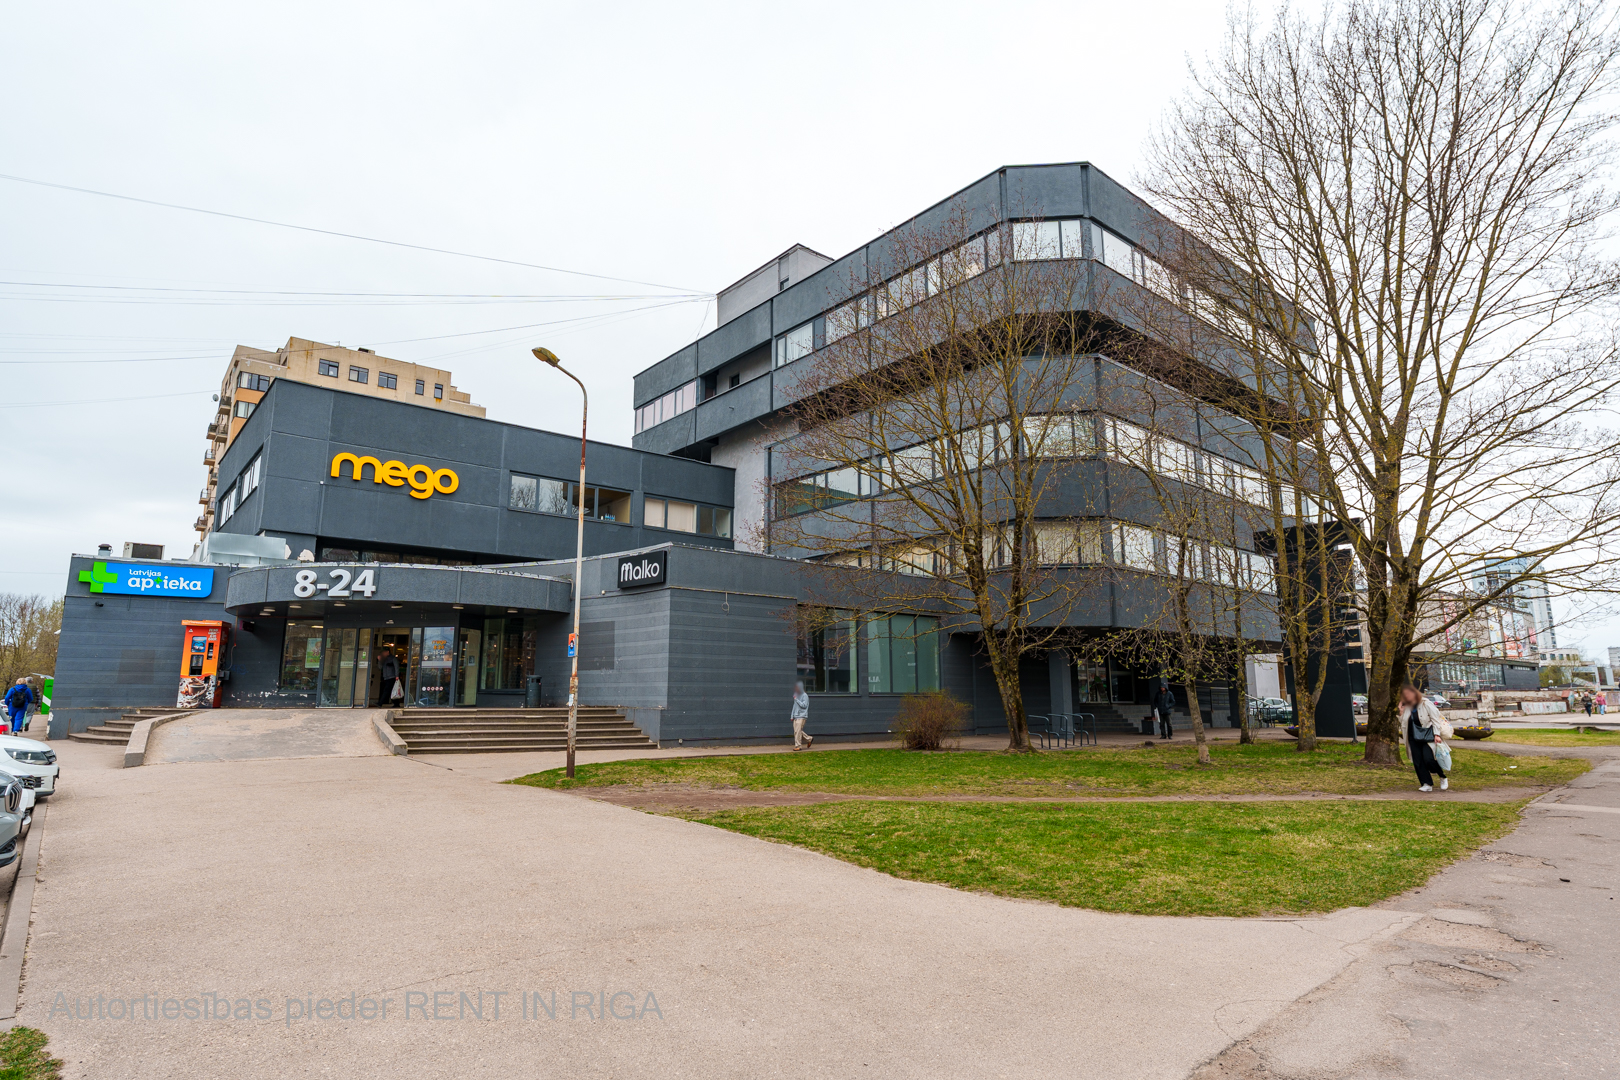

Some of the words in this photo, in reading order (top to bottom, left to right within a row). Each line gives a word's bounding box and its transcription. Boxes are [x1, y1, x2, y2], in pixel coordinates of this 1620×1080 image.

[330, 452, 460, 500] mego
[293, 568, 377, 598] 8-24
[620, 559, 660, 582] Malko
